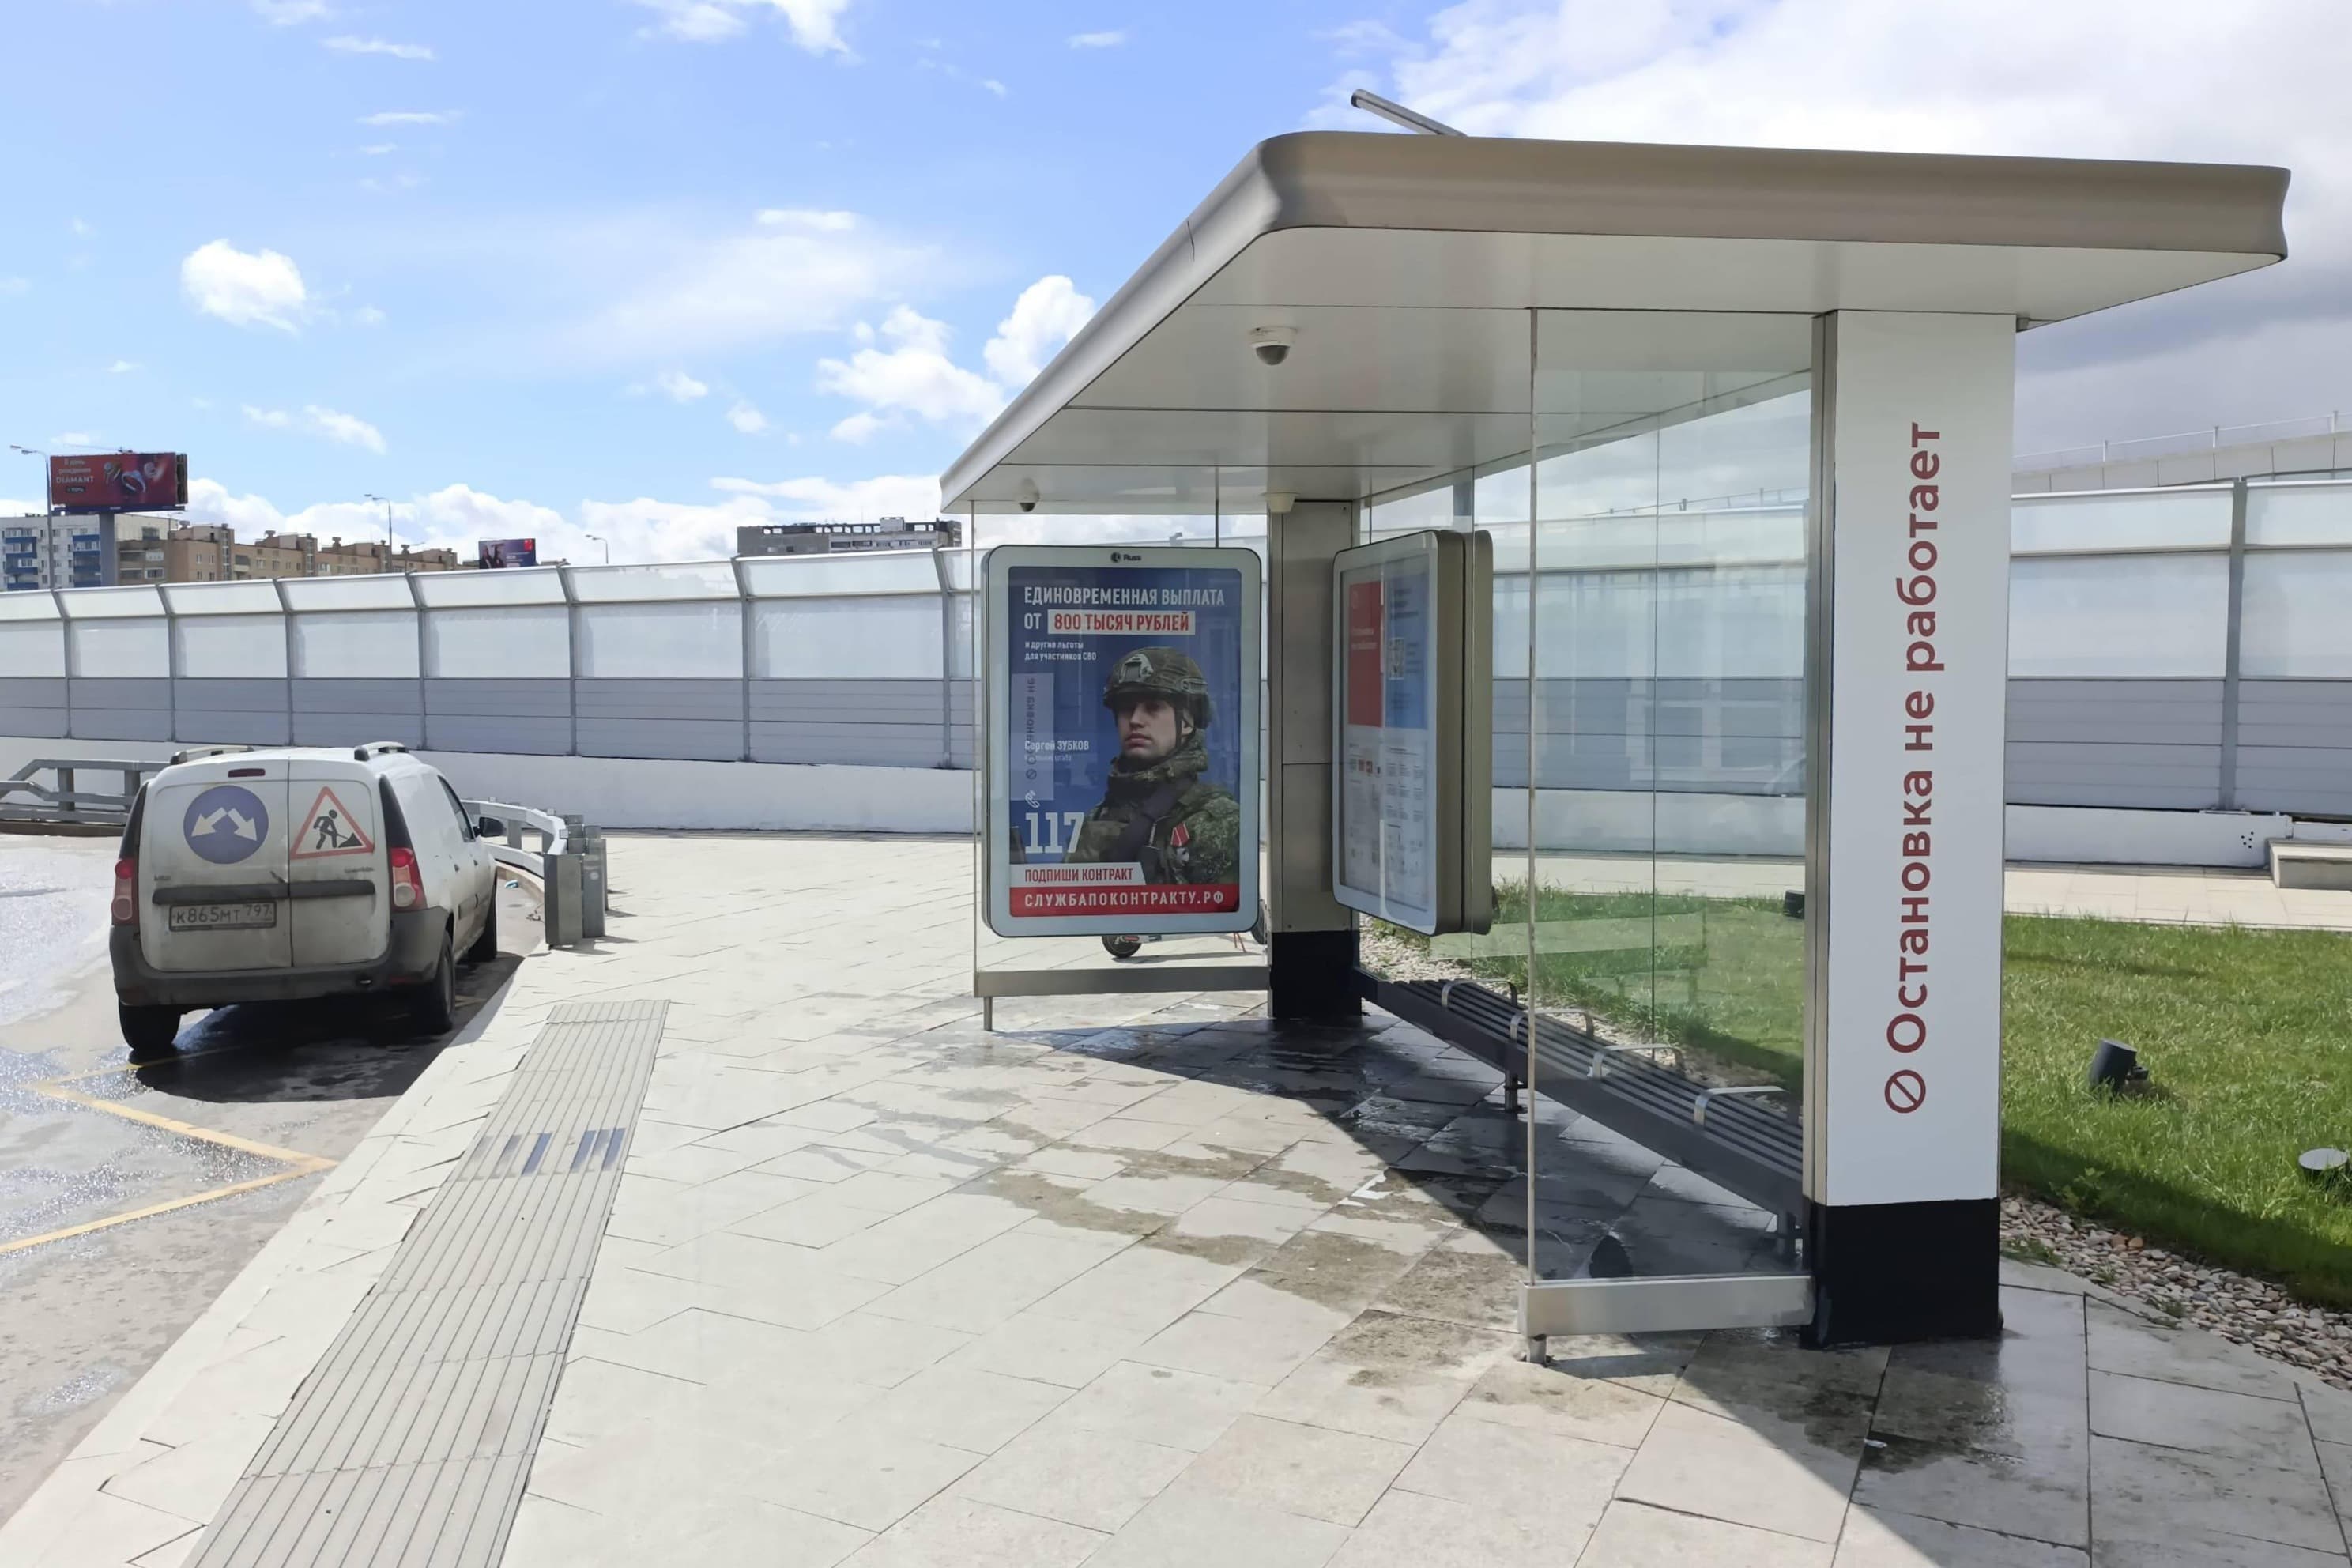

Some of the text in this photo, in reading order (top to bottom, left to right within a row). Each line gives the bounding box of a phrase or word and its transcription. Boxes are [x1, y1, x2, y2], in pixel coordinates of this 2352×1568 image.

[1024, 586, 1224, 606] ЕДИНОВРЕМЕННАЯ ВЫПЛАТА
[1024, 611, 1189, 631] ОТ 800 ТЫСЯЧ РУБЛЕЙ
[1031, 642, 1056, 650] другие
[1039, 652, 1082, 662] участников
[1083, 652, 1097, 661] СВО
[1024, 740, 1090, 752] Сергей ЗУБКОВ
[1886, 422, 1945, 1054] Остановка не работает
[1025, 812, 1084, 854] 117
[1025, 868, 1133, 883] ПОДПИШИ КОНТРАКТ
[1024, 891, 1224, 908] СЛУЖБАПОКОНТРАКТУ.РФ
[246, 904, 270, 916] 797
